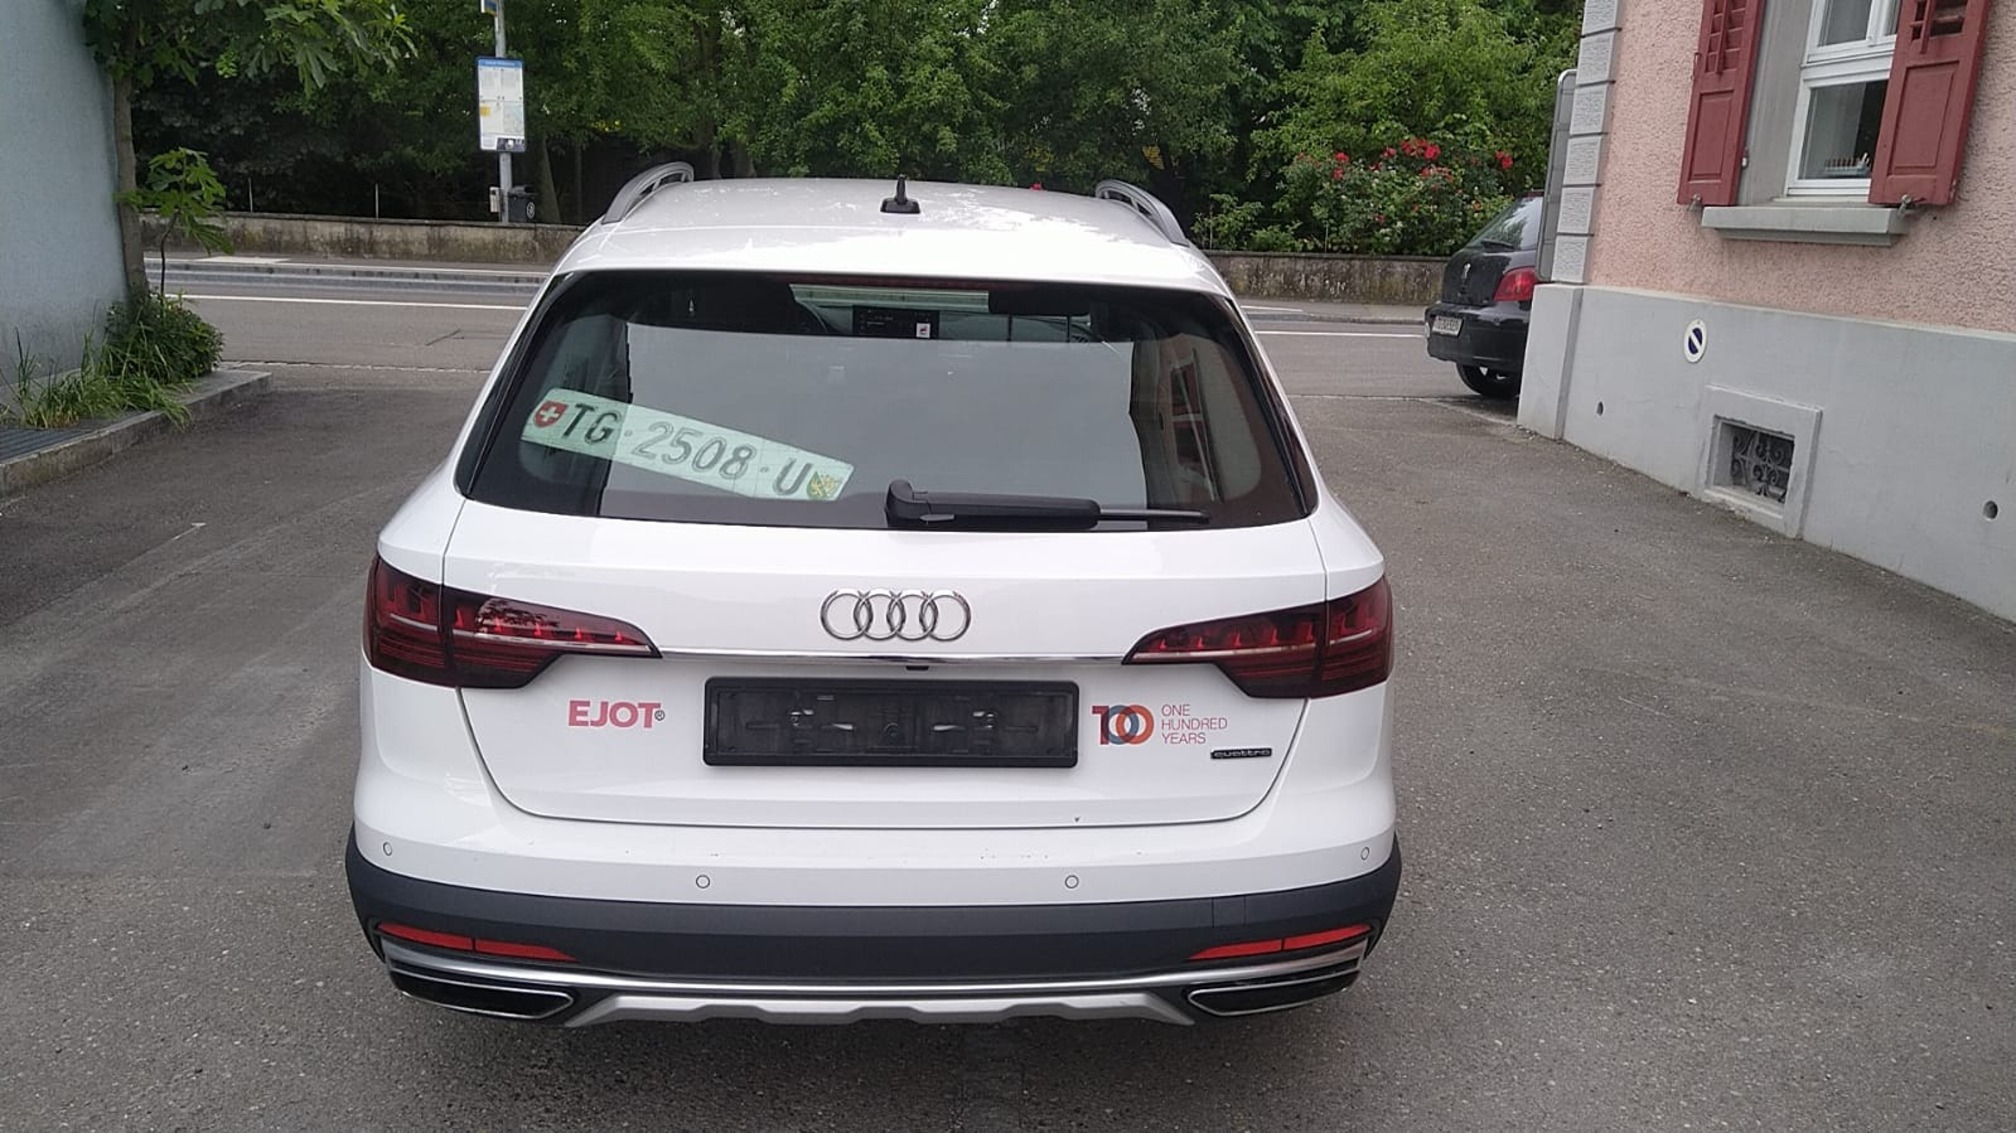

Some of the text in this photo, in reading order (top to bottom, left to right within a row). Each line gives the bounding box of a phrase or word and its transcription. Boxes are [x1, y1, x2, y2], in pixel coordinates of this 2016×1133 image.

[1161, 704, 1191, 717] ONE
[1092, 704, 1155, 746] 100
[1161, 718, 1228, 731] HUNDRED
[1162, 732, 1207, 745] YEARS
[1213, 749, 1271, 758] quattro
